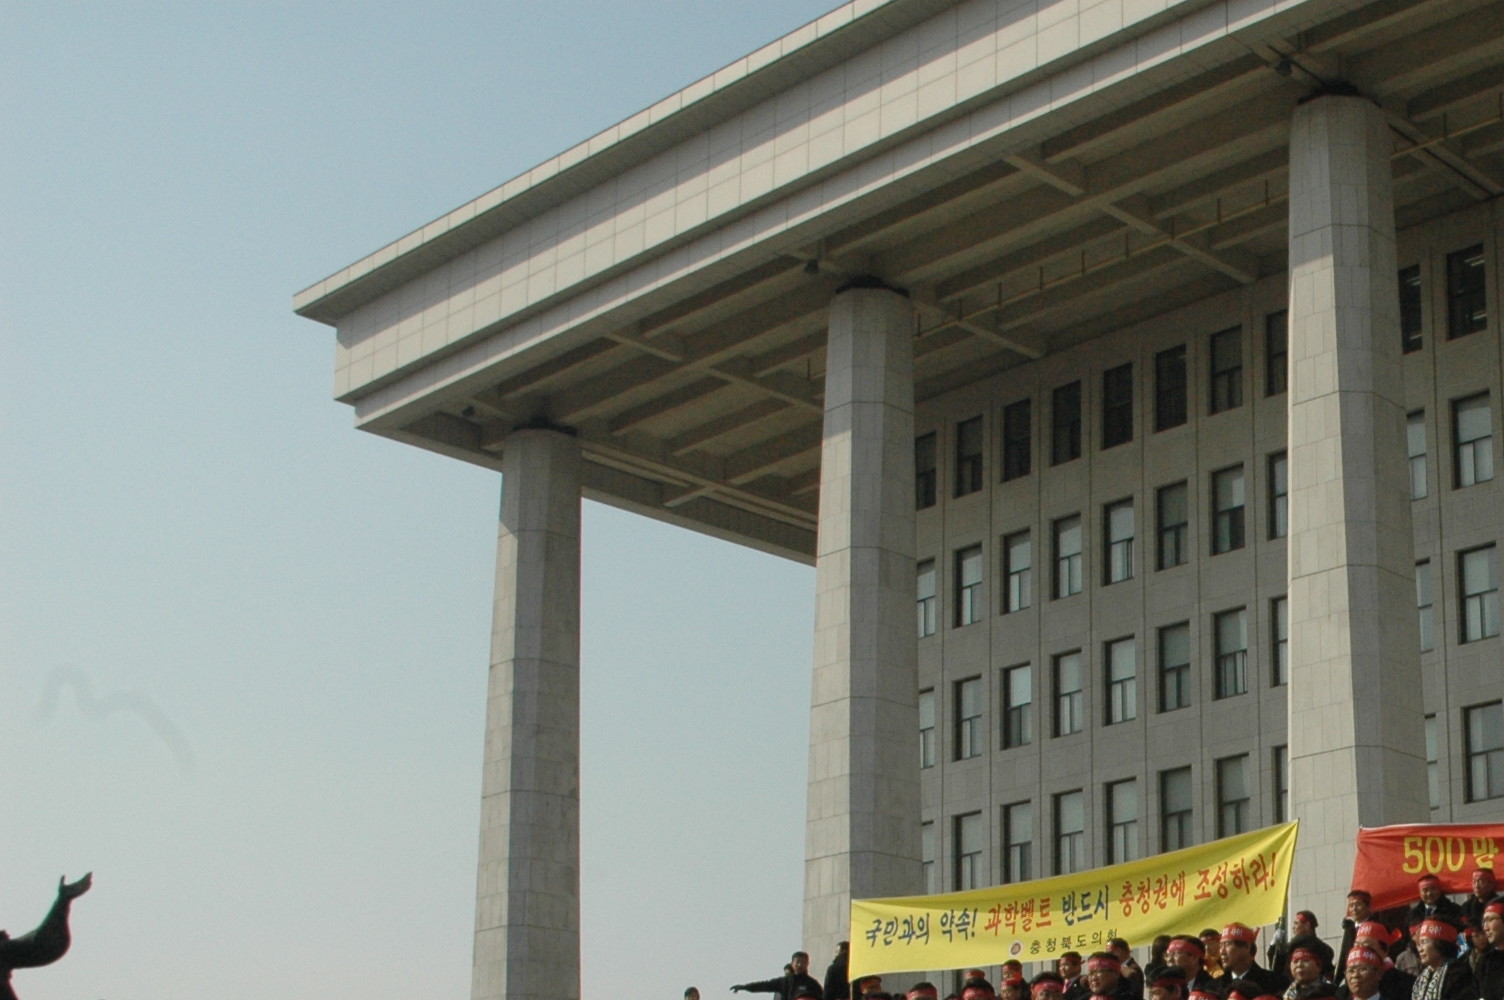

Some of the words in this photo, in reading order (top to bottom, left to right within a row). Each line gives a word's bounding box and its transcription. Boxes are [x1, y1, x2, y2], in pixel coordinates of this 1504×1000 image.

[864, 913, 930, 948] 국민과의
[939, 907, 977, 943] 약속!
[983, 896, 1052, 937] 과학벨트
[1061, 884, 1110, 926] 반드시
[1118, 870, 1186, 918] 충청권에
[1193, 852, 1277, 901] 조성하라!
